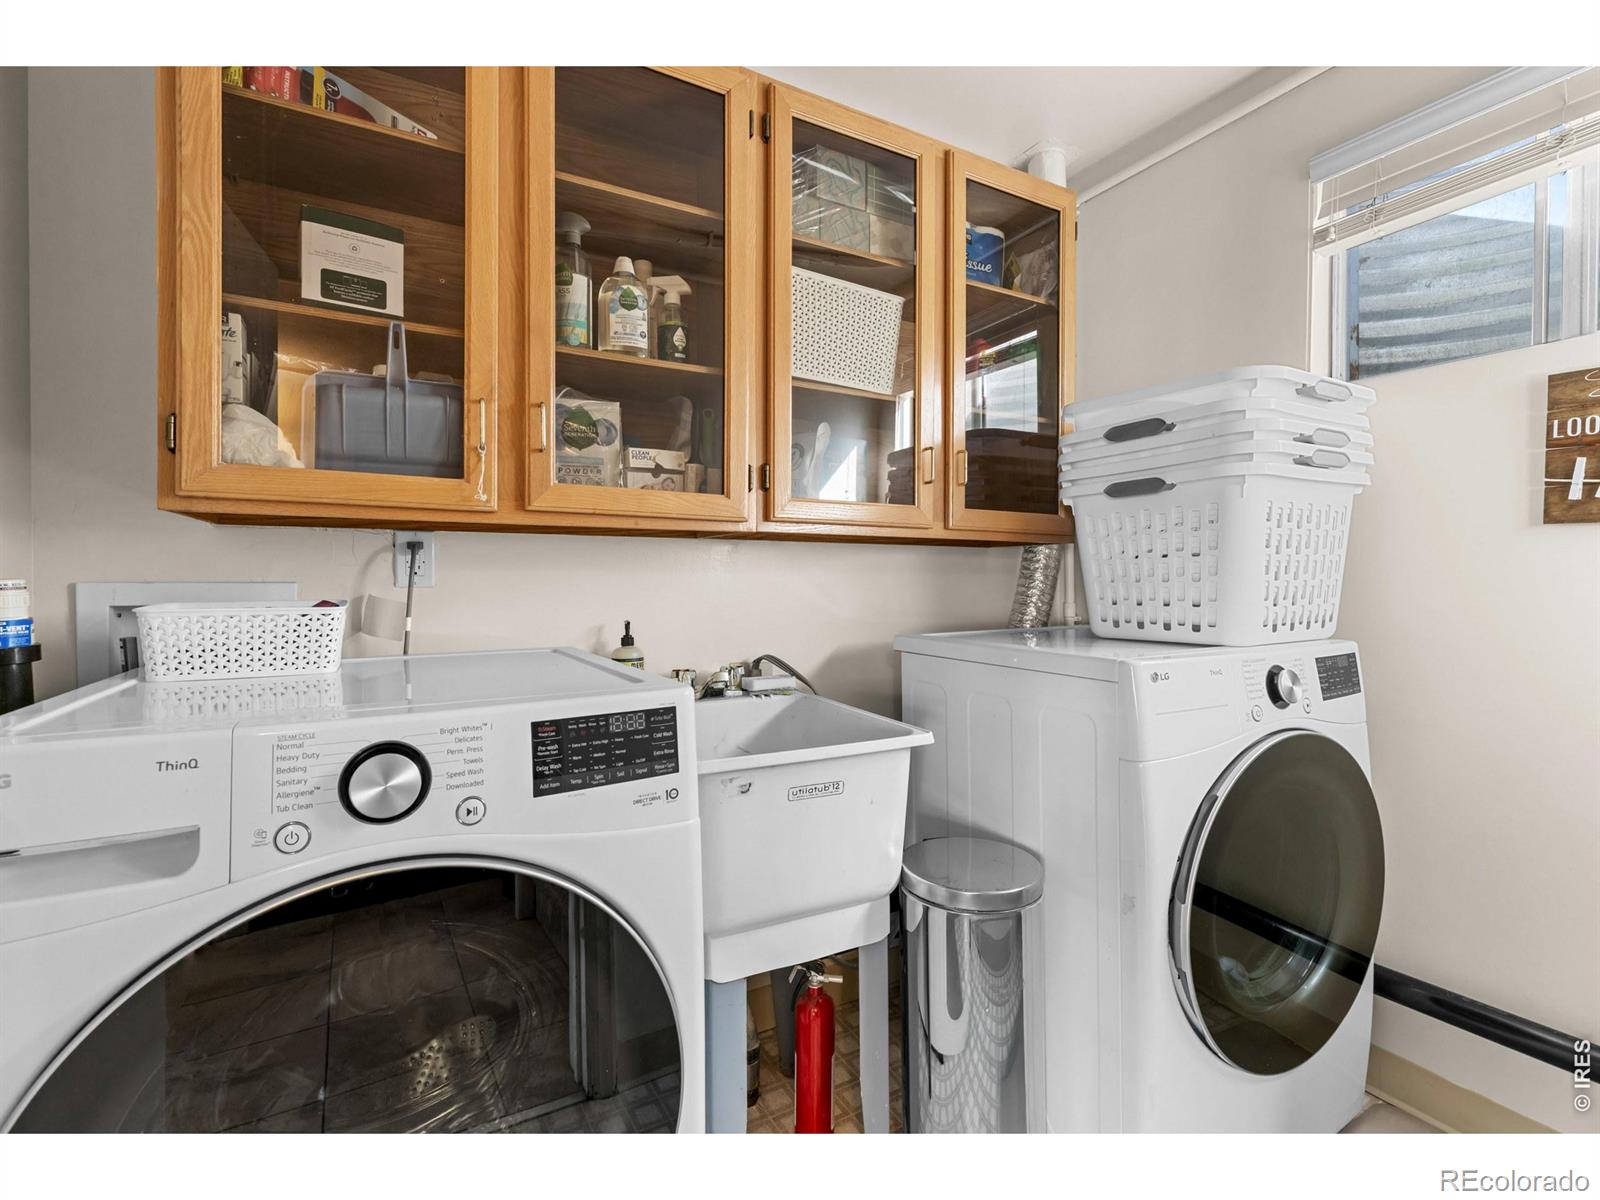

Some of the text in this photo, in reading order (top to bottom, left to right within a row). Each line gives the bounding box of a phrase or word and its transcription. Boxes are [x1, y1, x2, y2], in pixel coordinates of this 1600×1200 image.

[966, 259, 992, 272] ssue
[631, 453, 652, 461] PEOPLE
[558, 467, 602, 475] POWDER
[1160, 672, 1170, 681] LG
[440, 727, 459, 736] Bright
[454, 735, 483, 743] Delicates
[276, 742, 304, 751] Normal
[466, 745, 484, 753] Press
[276, 752, 320, 762] Heavy Duty
[463, 757, 484, 765] Towels
[156, 758, 199, 772] ThinQ
[276, 766, 307, 775] Bedding
[446, 768, 484, 779] Speed Wash
[276, 778, 308, 787] Sanitary
[446, 780, 485, 791] Downloaded
[665, 787, 679, 801] 10
[276, 802, 314, 813] Tub Clean
